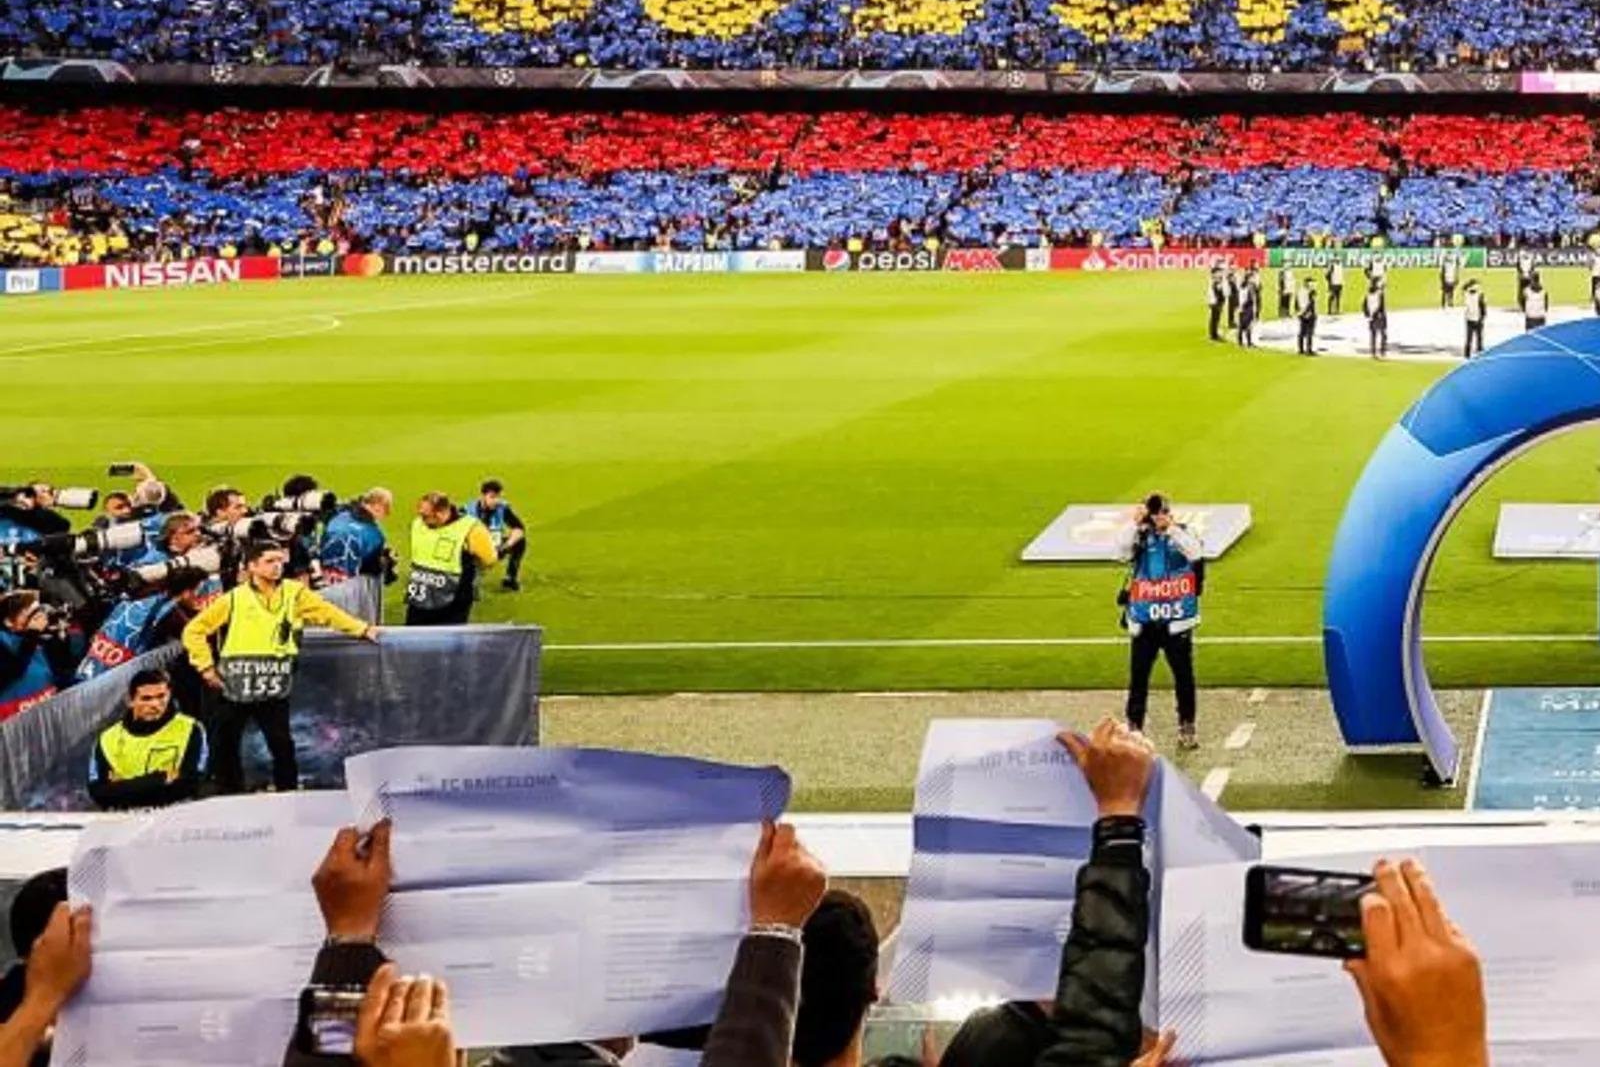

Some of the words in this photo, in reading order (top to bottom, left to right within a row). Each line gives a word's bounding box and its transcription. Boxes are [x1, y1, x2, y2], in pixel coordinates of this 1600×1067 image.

[394, 249, 567, 274] mastercard
[858, 248, 936, 273] pepsi
[1106, 248, 1236, 271] Santander
[105, 258, 241, 288] NISSAN
[1138, 578, 1190, 598] PHOTO
[1149, 601, 1184, 622] 005
[227, 660, 291, 675] STEWAR
[242, 674, 282, 695] 155
